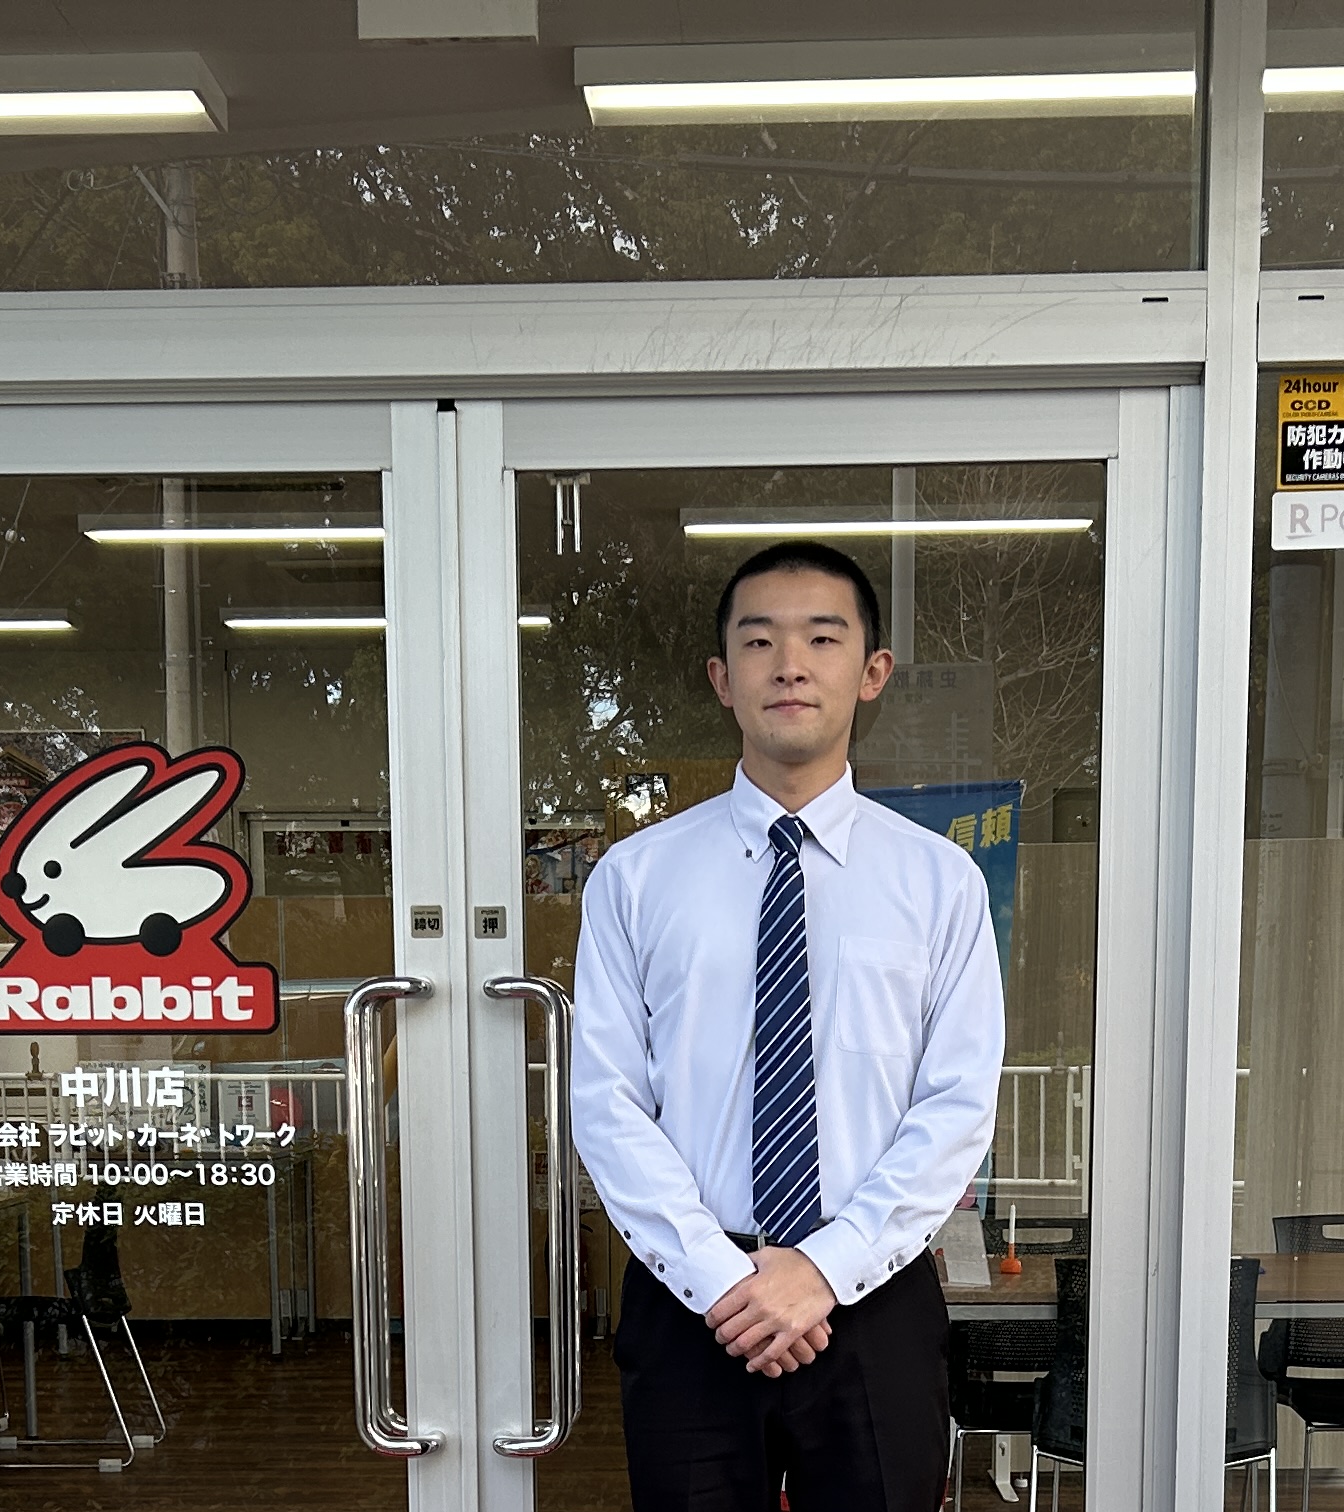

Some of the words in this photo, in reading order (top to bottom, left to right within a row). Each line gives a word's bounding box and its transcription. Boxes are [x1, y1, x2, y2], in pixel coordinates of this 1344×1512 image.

[1283, 378, 1340, 394] 24hour
[1290, 400, 1332, 411] CCD
[945, 803, 1014, 852] 信頼
[60, 1066, 186, 1108] 中川店
[51, 1202, 124, 1227] 定休日
[134, 1202, 206, 1227] 火曜日
